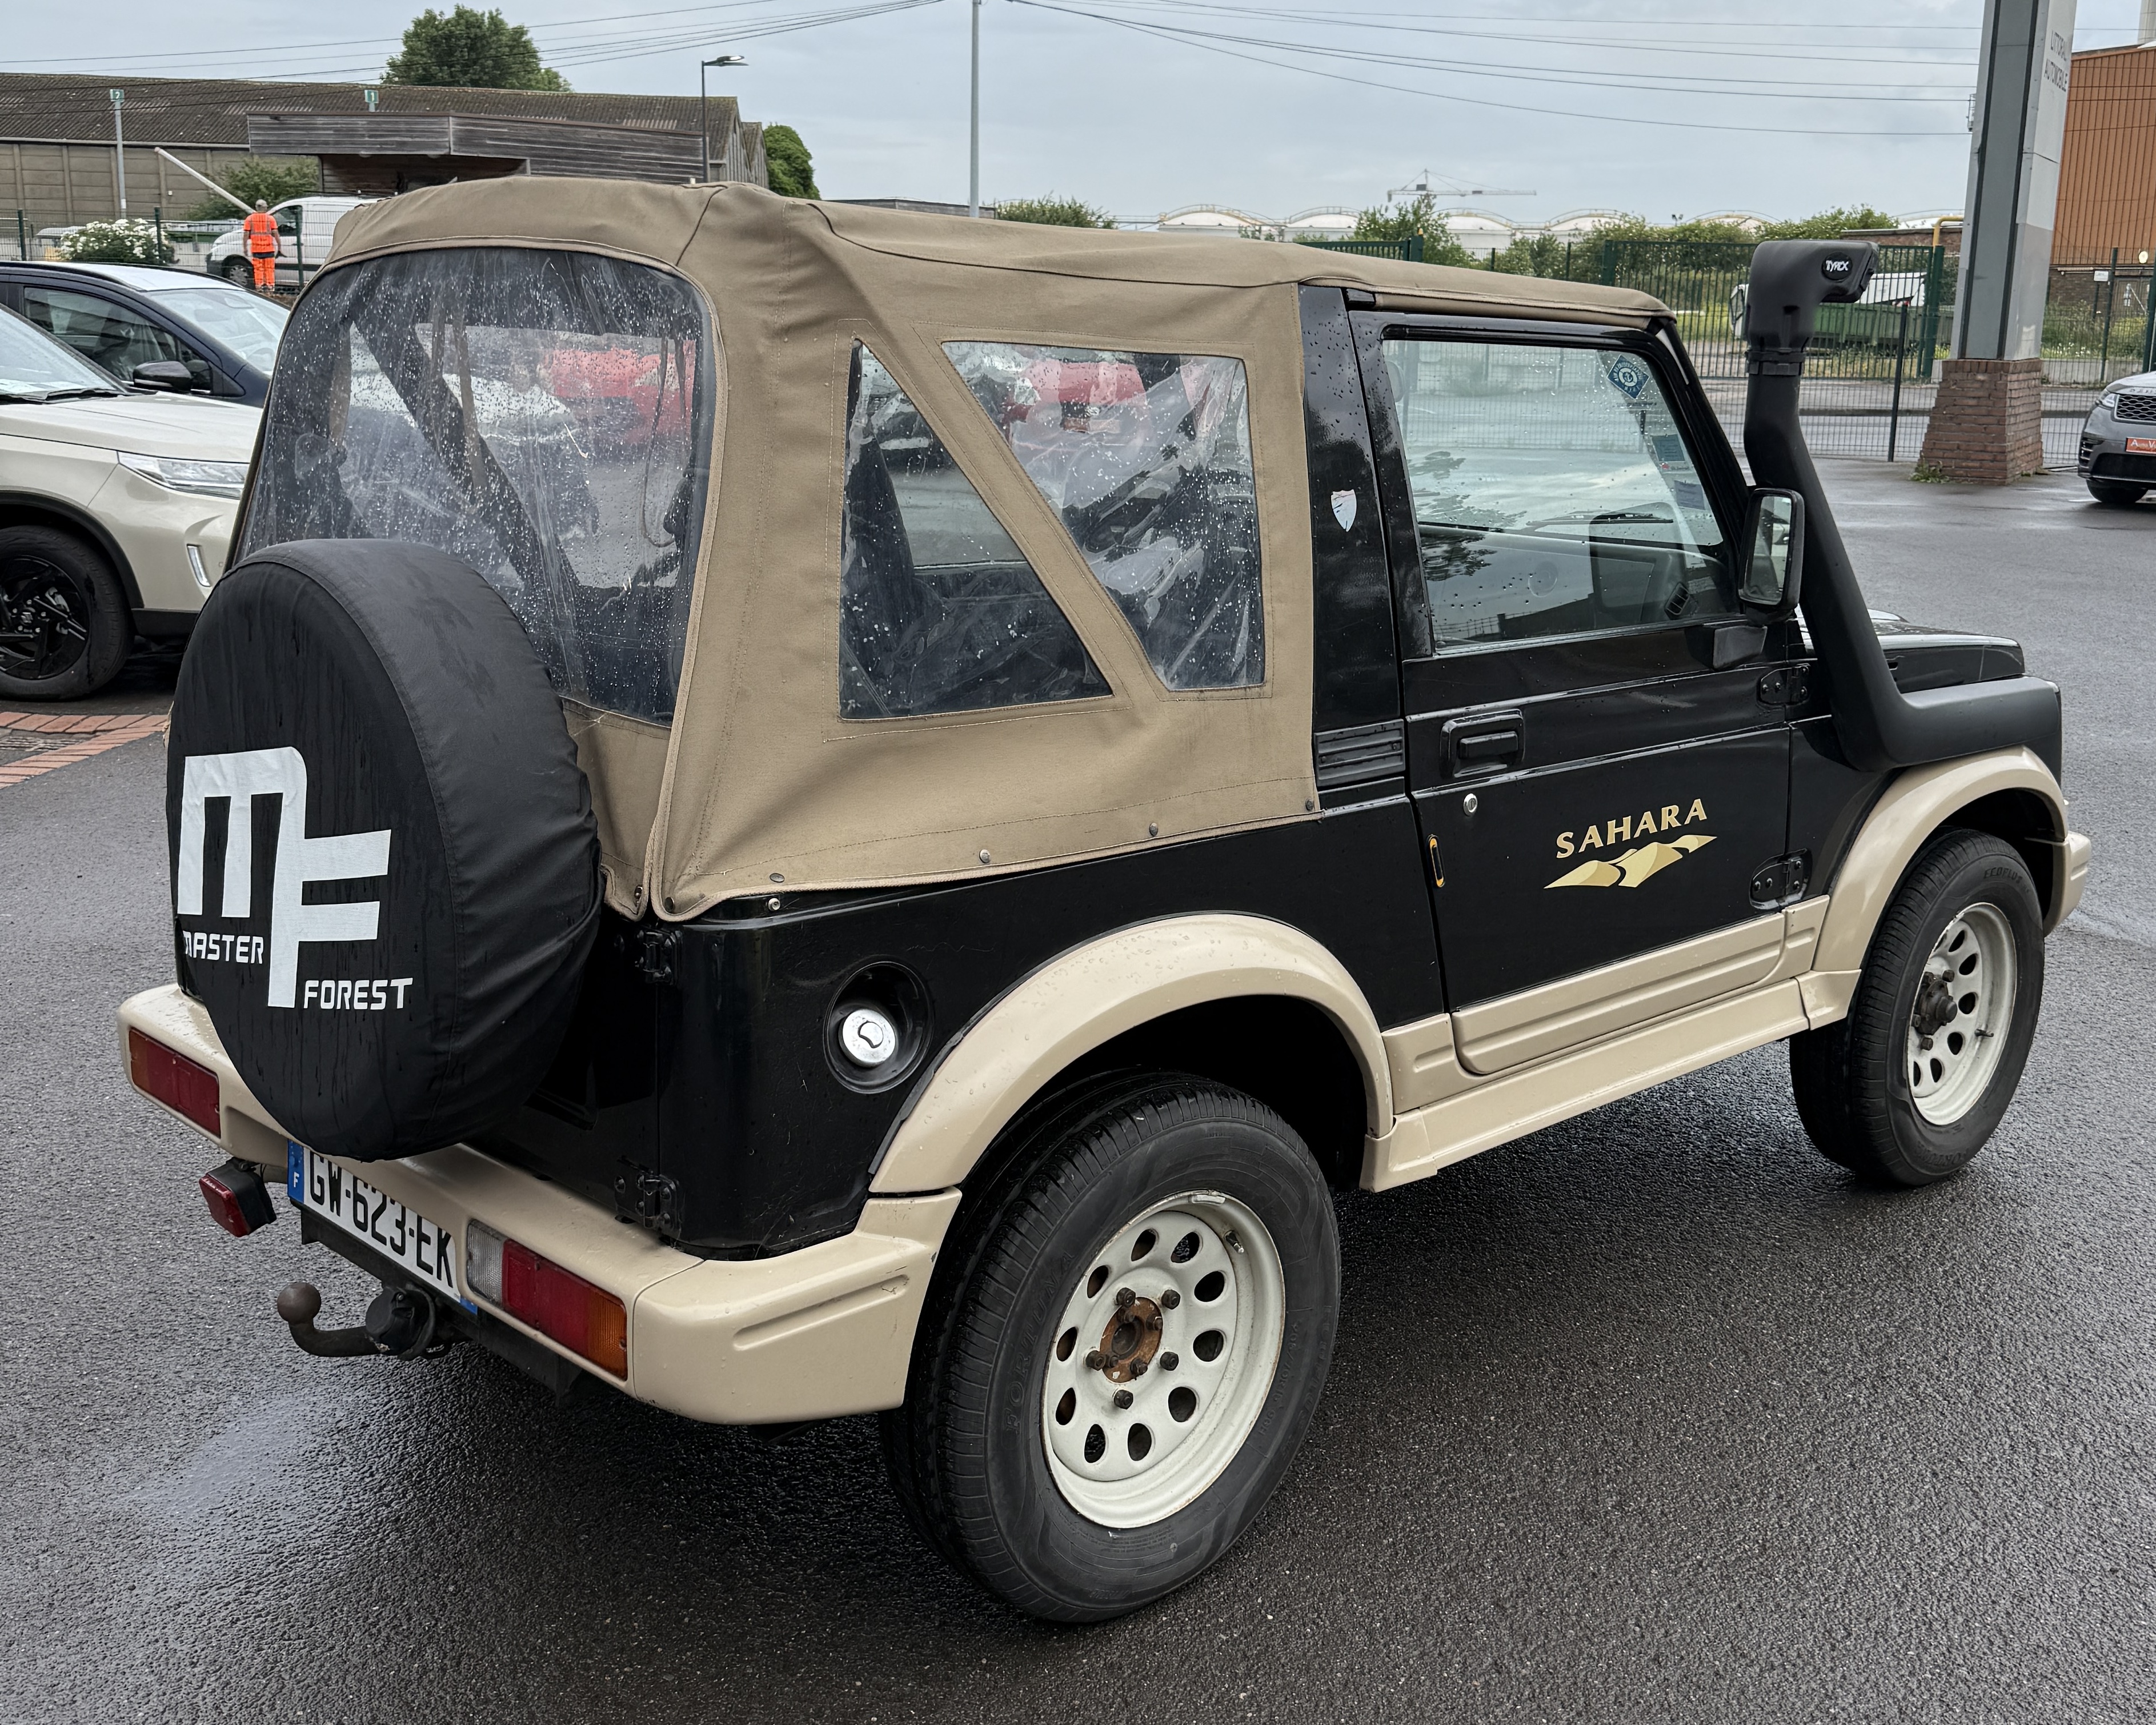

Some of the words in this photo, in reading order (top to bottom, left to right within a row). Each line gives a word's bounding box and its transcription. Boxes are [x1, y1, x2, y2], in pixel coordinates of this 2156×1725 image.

[1556, 798, 1708, 859] SAHARA
[182, 930, 264, 964] MASTER
[303, 978, 413, 1010] FOREST
[293, 1171, 300, 1188] F
[1003, 1250, 1075, 1434] FORTUNA
